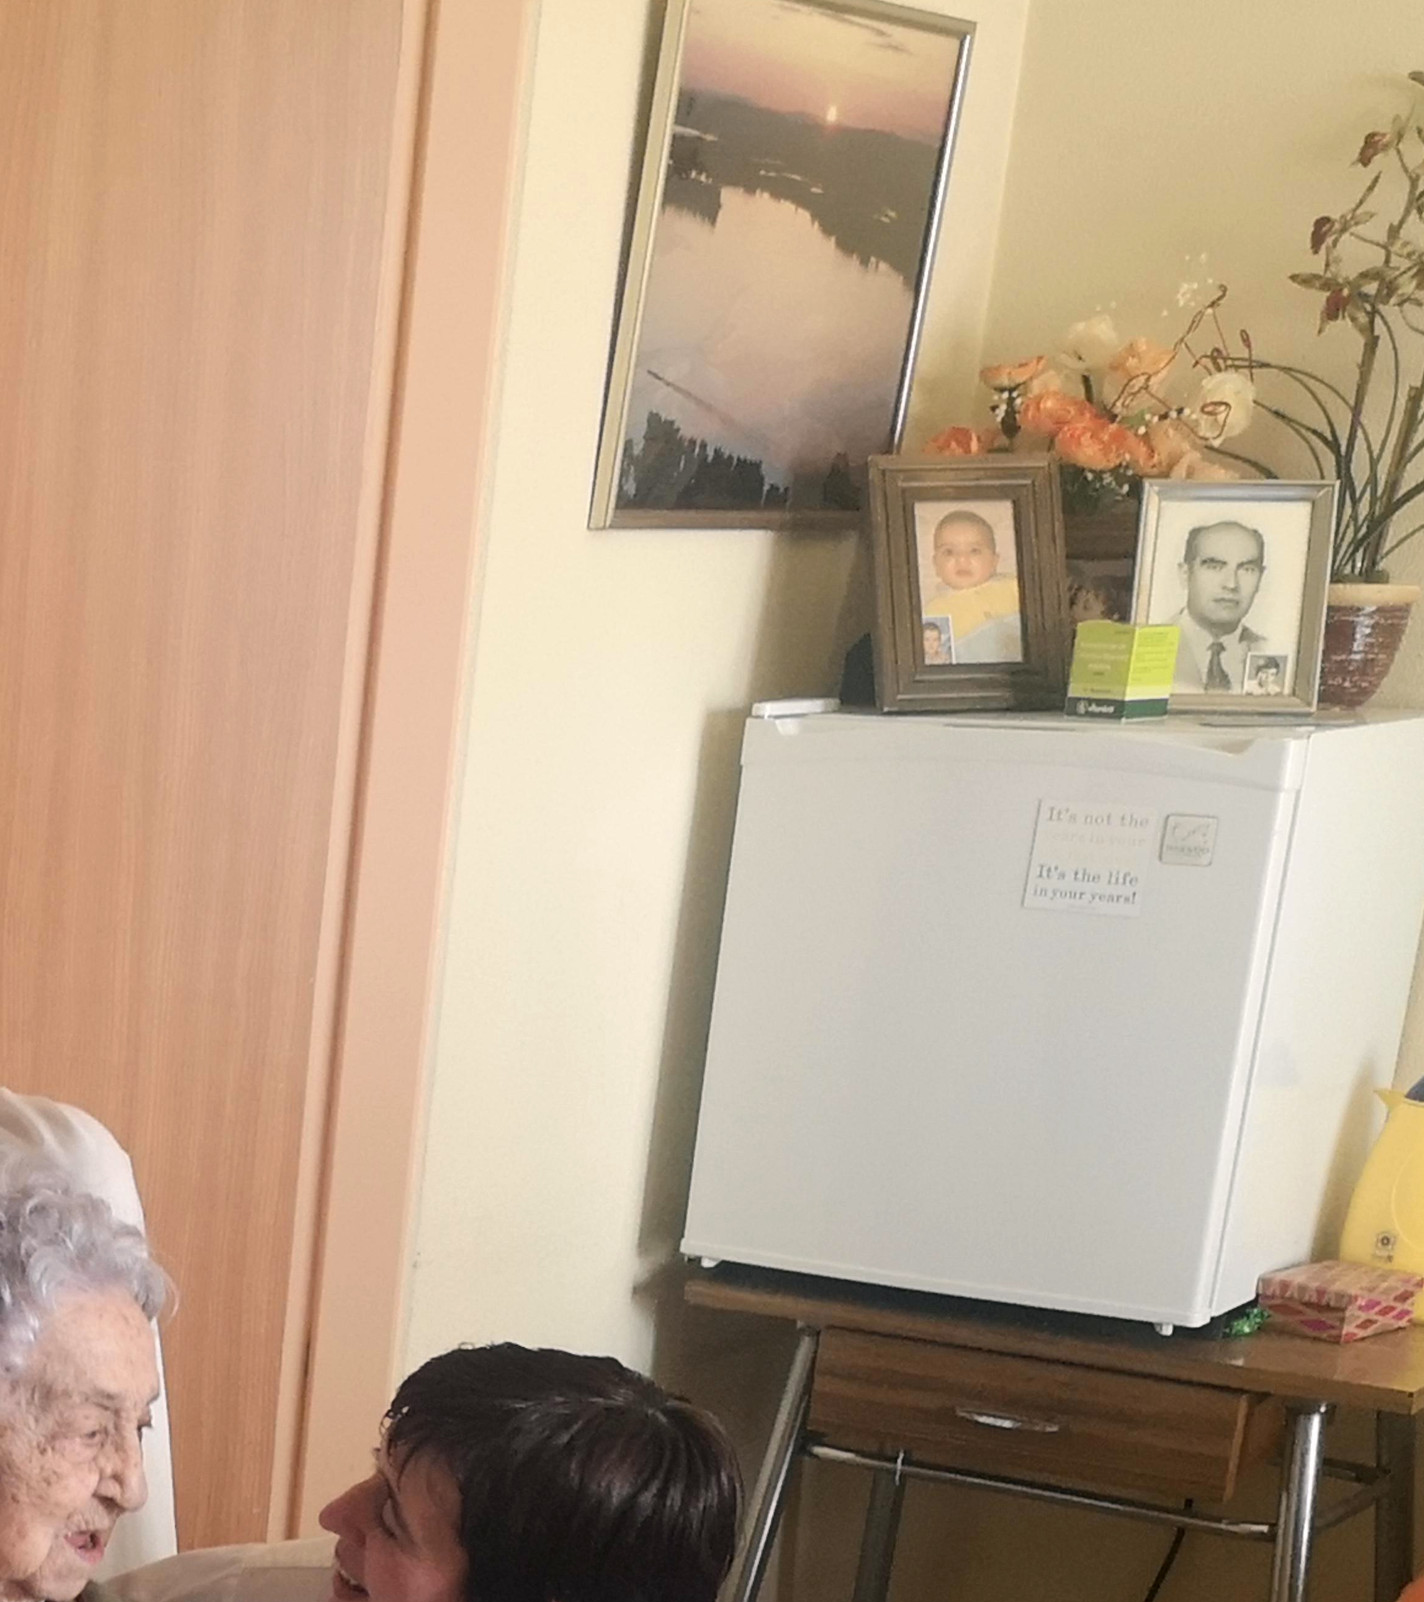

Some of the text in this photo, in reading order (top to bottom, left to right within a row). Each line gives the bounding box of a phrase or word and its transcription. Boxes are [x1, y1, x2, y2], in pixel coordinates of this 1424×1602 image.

[1047, 806, 1150, 829] It's not the
[1036, 863, 1140, 887] It's the life
[1033, 885, 1137, 905] in your years!
